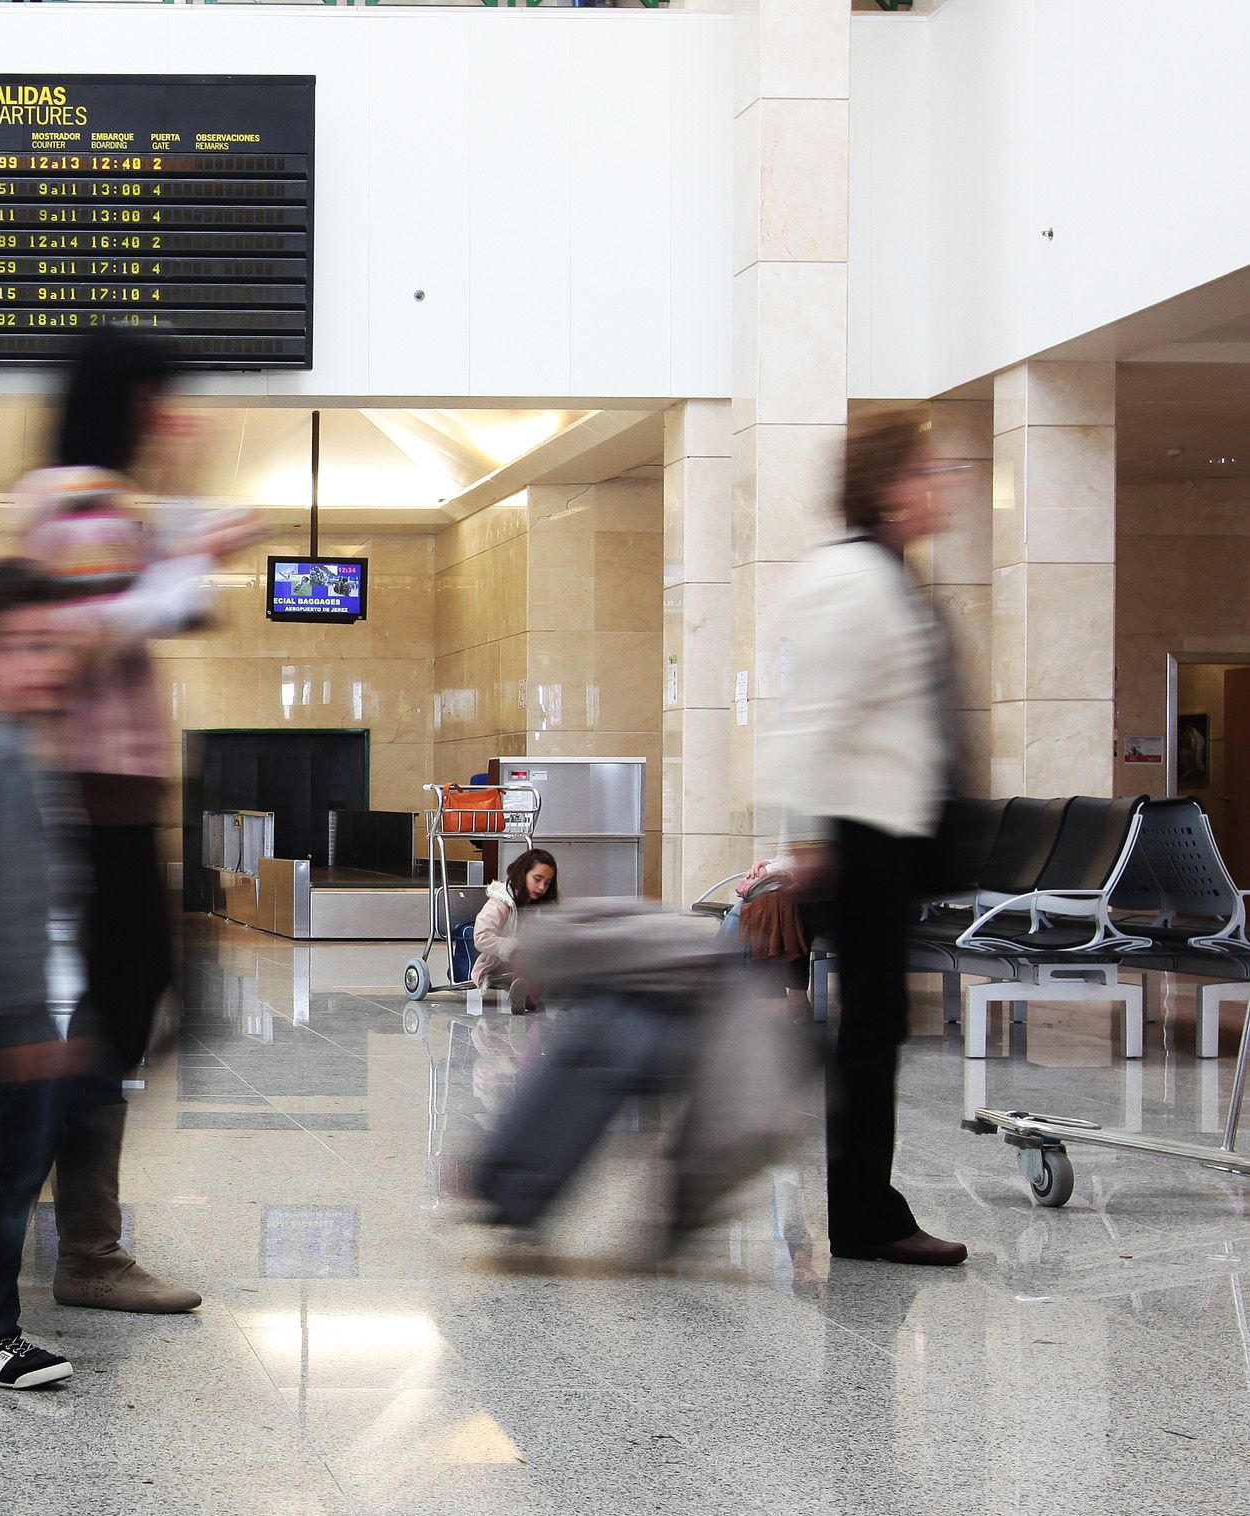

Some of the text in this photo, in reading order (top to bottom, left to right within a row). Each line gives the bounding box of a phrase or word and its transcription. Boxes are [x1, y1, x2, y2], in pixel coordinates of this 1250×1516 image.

[196, 134, 260, 142] OBSERVACIONES
[152, 142, 169, 150] GATE
[196, 142, 228, 150] REMARKS
[30, 158, 80, 169] 12a13
[92, 158, 140, 169] 12:40
[152, 158, 161, 169] 2
[39, 184, 76, 196] 9a11
[92, 184, 140, 196] 13:00
[152, 184, 161, 196] 4
[39, 210, 76, 222] 9a11
[92, 210, 140, 222] 13:00
[152, 210, 161, 222] 4
[30, 236, 78, 248] 12a14
[92, 236, 140, 248] 16:40
[152, 236, 161, 248] 2
[39, 263, 76, 274] 9a11
[92, 263, 140, 274] 17:10
[152, 263, 161, 274] 4
[39, 289, 76, 300] 9a11
[92, 289, 140, 300] 17:10
[152, 289, 161, 300] 4
[30, 314, 78, 326] 18a19
[152, 315, 158, 326] 1
